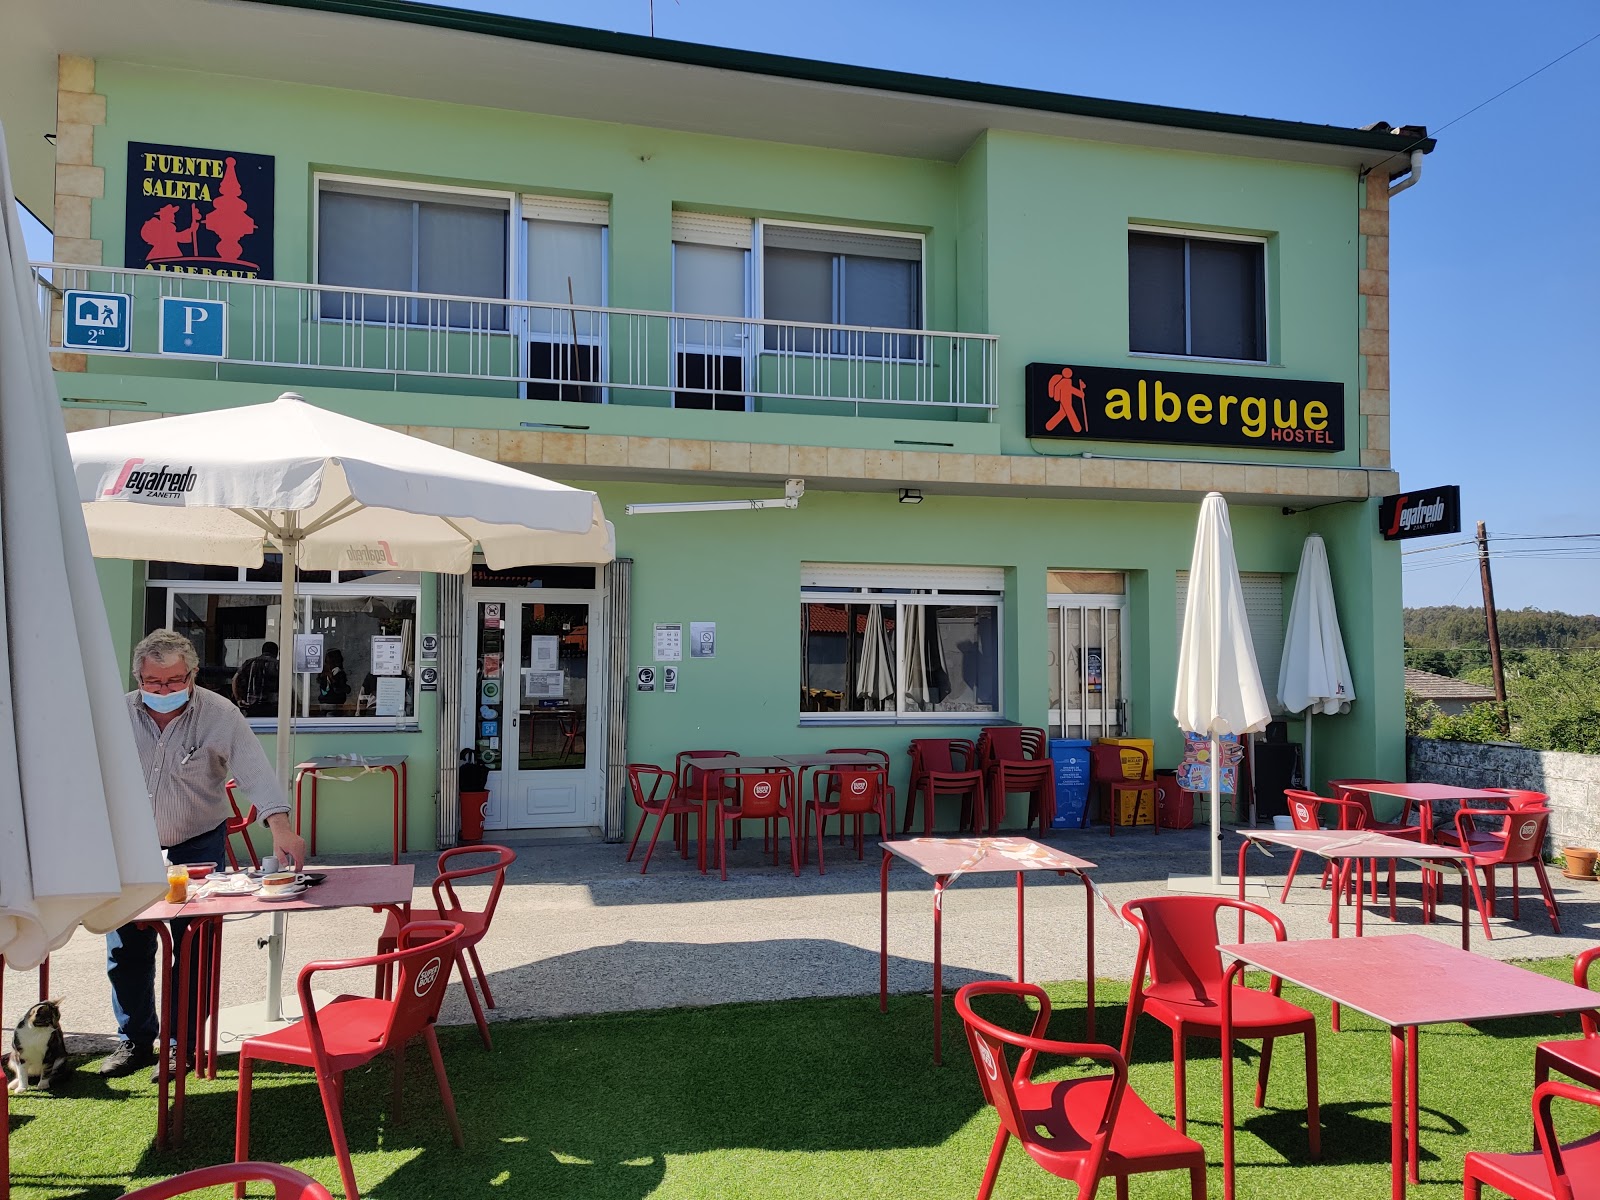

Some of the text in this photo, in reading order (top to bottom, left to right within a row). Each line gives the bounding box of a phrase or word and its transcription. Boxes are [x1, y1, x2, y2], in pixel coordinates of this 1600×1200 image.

[144, 153, 224, 178] FUENTE
[143, 178, 212, 202] SALETA
[183, 306, 209, 335] P
[1104, 379, 1329, 438] albergue
[1271, 427, 1334, 444] HOSTEL
[103, 457, 198, 496] Segafredo
[146, 490, 181, 499] ZANETTI
[1387, 496, 1445, 536] Segafredo
[1412, 522, 1435, 531] ZANETTI
[418, 973, 435, 988] BOCK
[420, 965, 439, 978] SUPER
